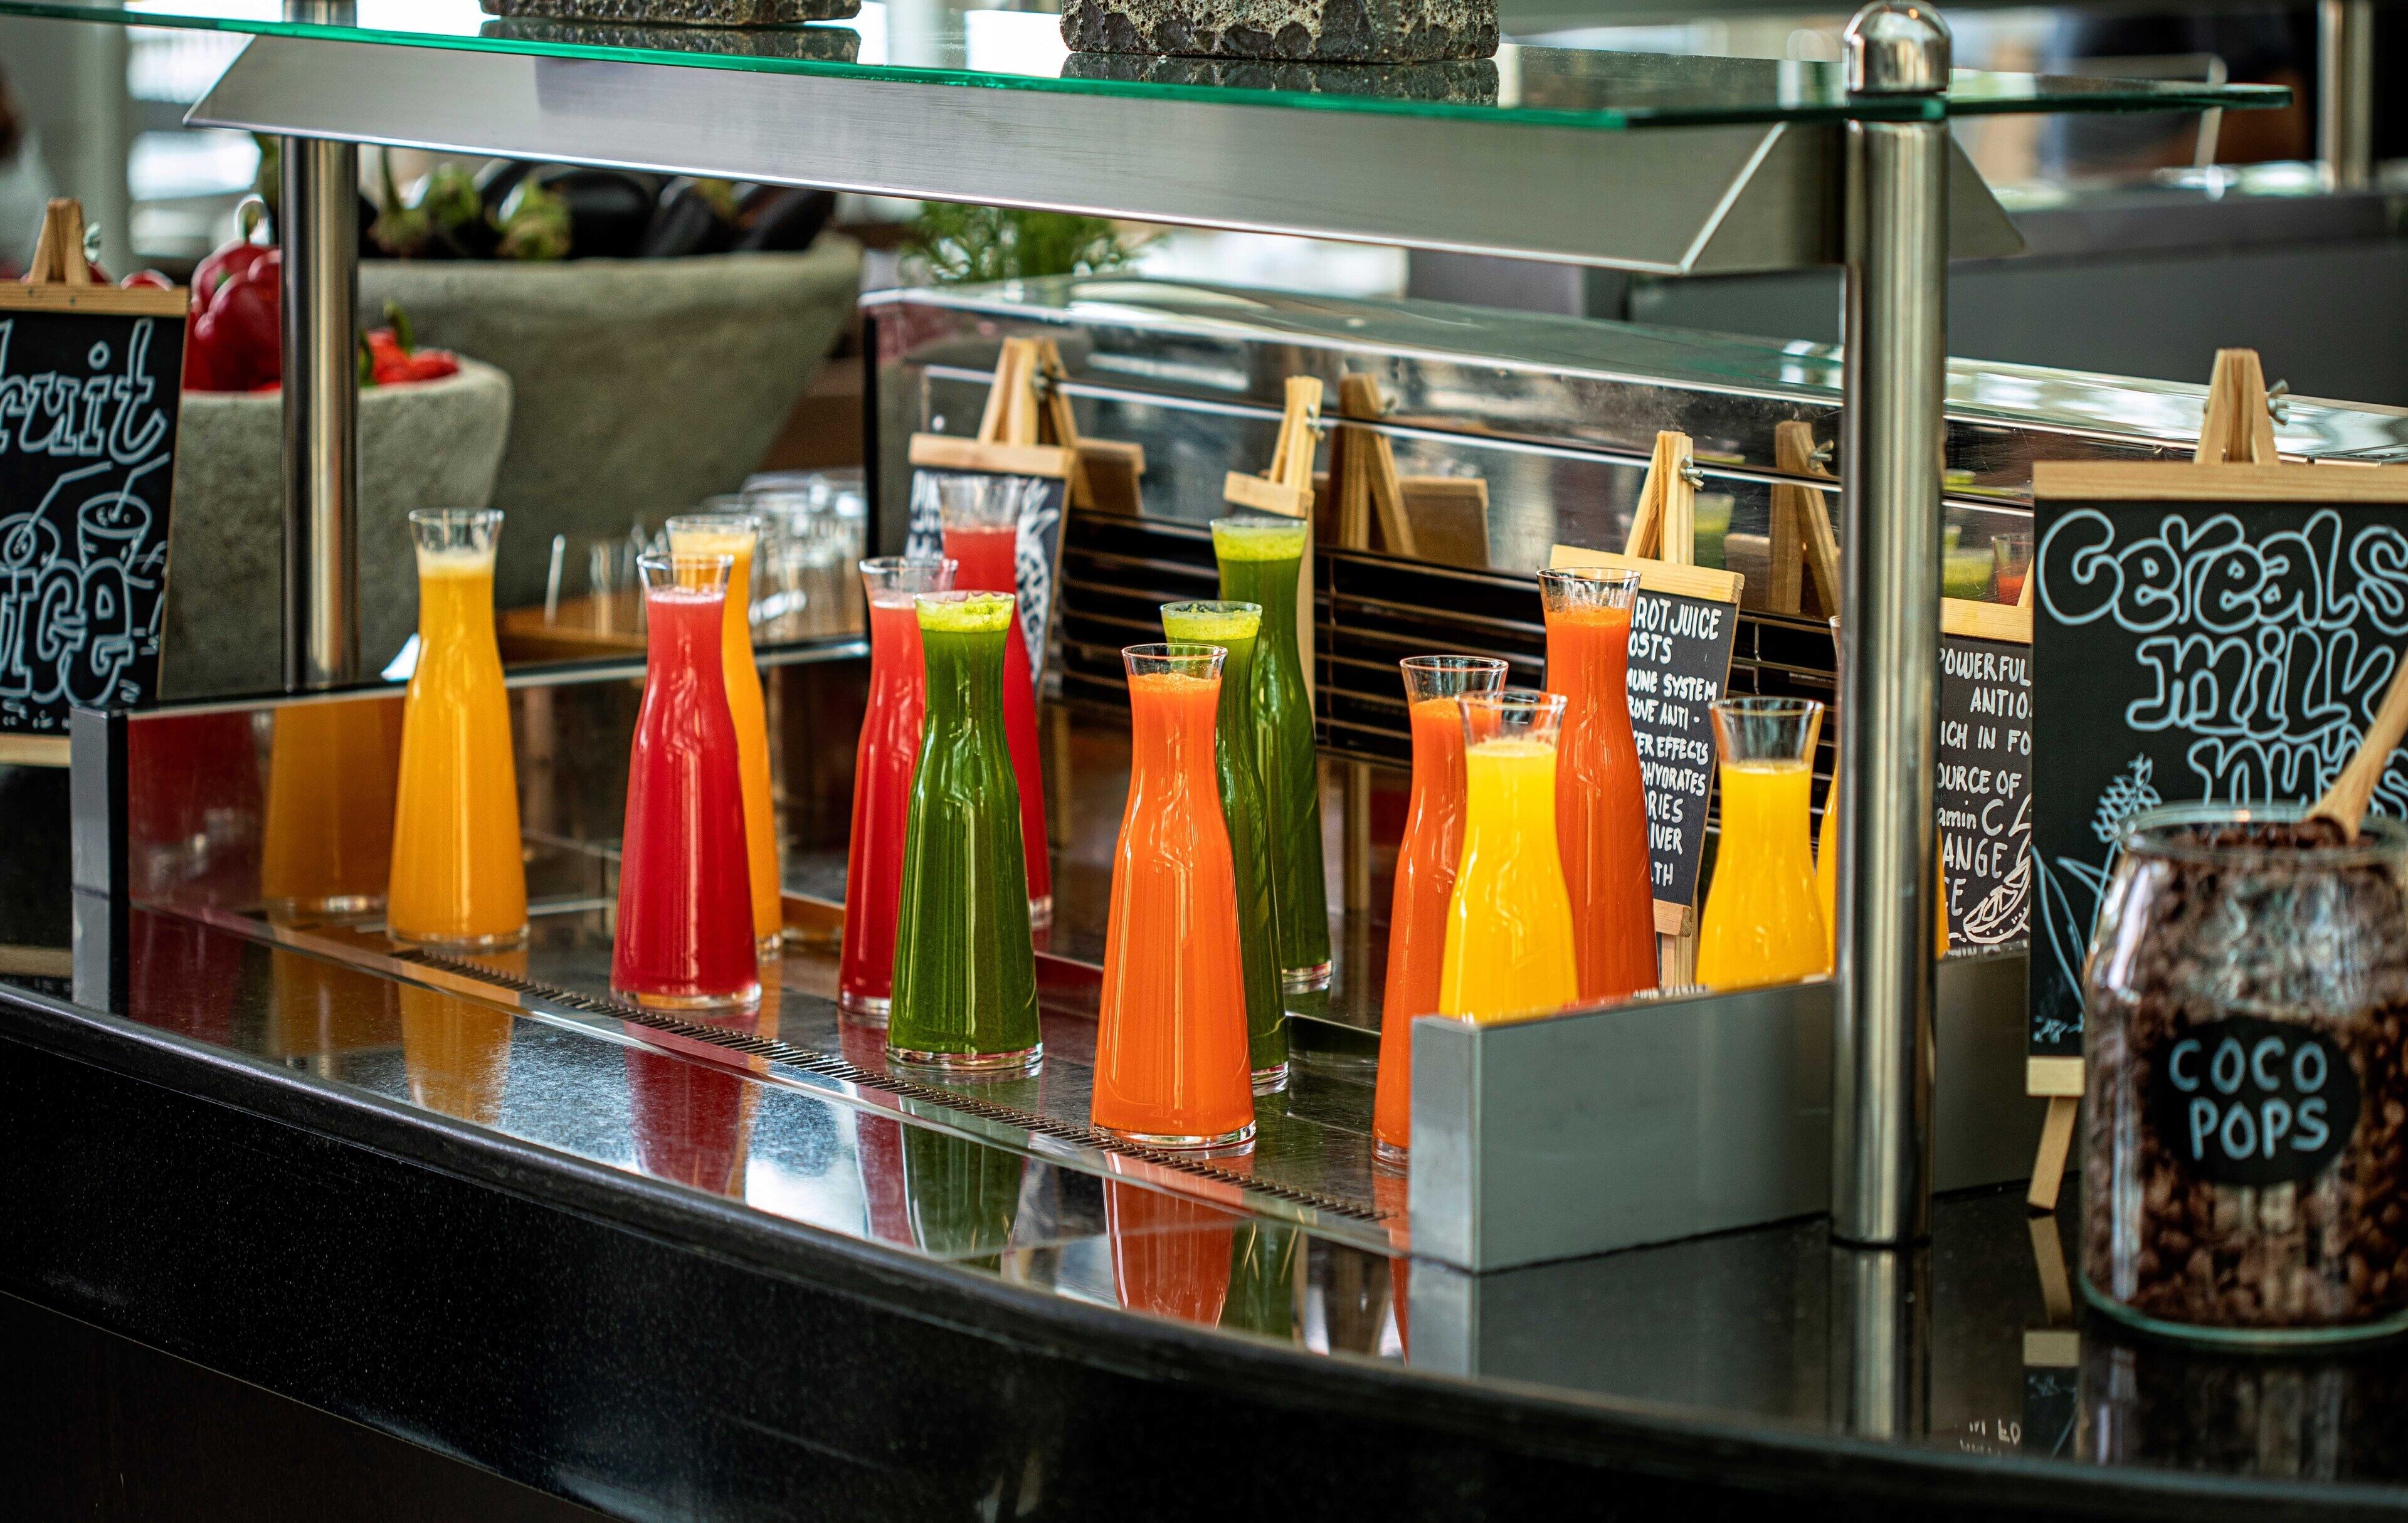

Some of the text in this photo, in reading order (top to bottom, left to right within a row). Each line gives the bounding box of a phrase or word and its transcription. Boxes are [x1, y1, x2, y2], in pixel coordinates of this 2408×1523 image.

[0, 317, 169, 464] ruit
[2037, 508, 2408, 636] Cereals
[1631, 596, 1722, 640] ROT JUICE
[1629, 630, 1673, 665] OSTS
[1664, 673, 1718, 702] SYSTEM
[1970, 686, 2032, 720] ANTIO
[1659, 702, 1689, 732] ANTI
[1633, 730, 1709, 766] ER EFFECTS
[1977, 725, 1997, 750] IN
[2007, 729, 2032, 756] FO
[1996, 769, 2022, 799] OF
[1644, 790, 1684, 823] RIES
[1982, 798, 2004, 836] C
[1943, 831, 2008, 879] ANGE
[1650, 862, 1674, 887] TH
[2168, 1036, 2328, 1094] COCO
[2189, 1097, 2330, 1161] POPS
